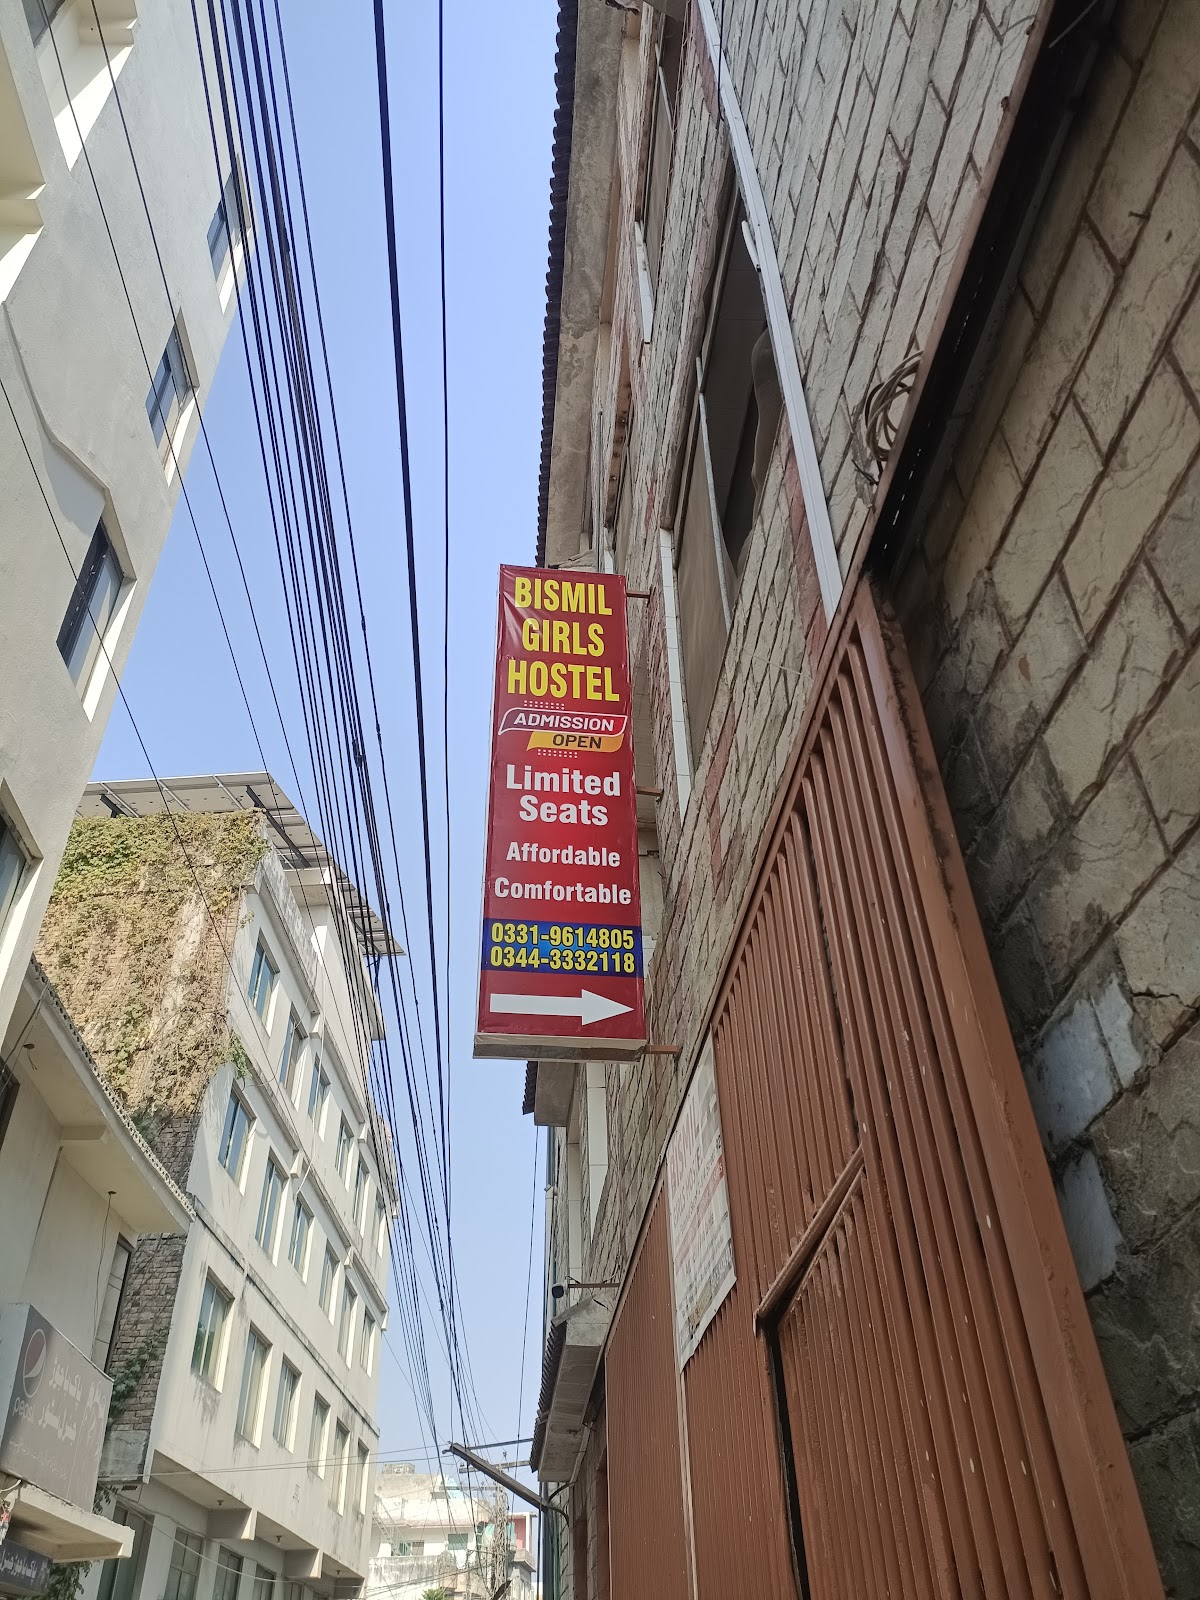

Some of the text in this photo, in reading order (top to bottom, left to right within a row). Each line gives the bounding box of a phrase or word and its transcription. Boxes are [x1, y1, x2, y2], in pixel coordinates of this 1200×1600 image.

[515, 576, 613, 616] BISMIL
[522, 617, 605, 657] GIRLS
[507, 659, 620, 702] HOSTEL
[513, 712, 615, 732] ADMISSION
[552, 733, 602, 749] OPEN
[506, 764, 621, 797] Limited
[519, 795, 609, 826] Seats
[506, 841, 621, 868] Affordable
[494, 877, 632, 905] Comfortable
[491, 922, 635, 950] 0331-9614805
[490, 946, 636, 974] 0344-3332118
